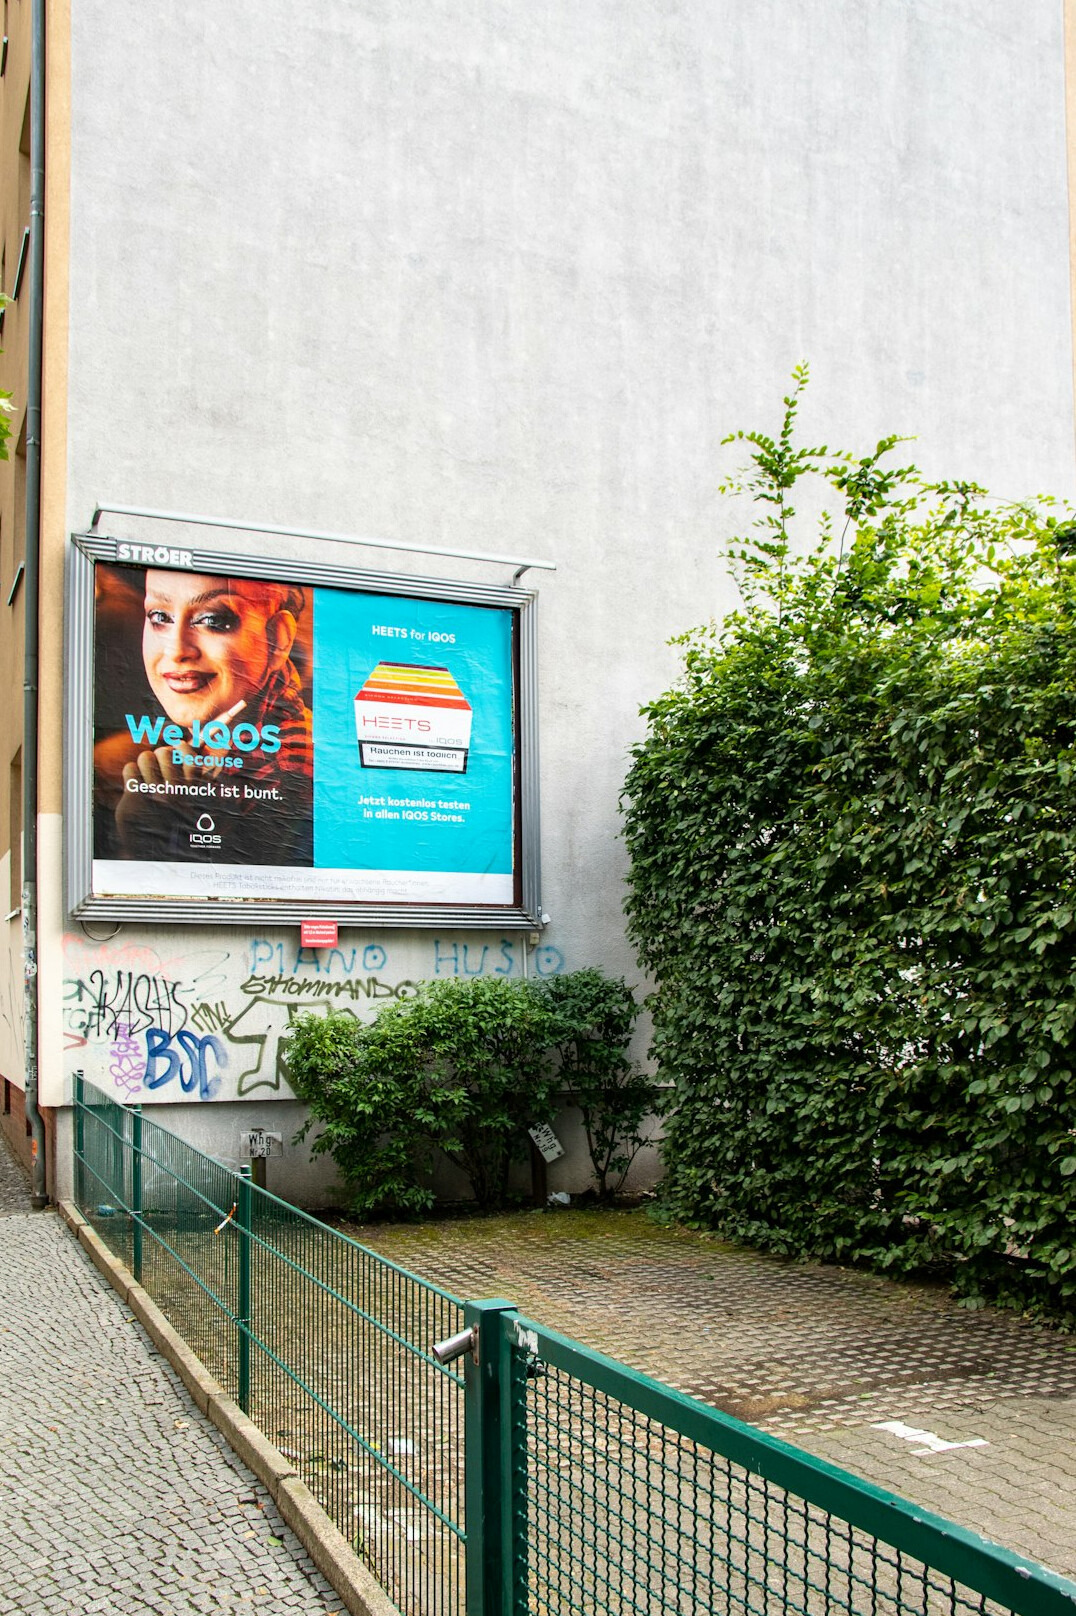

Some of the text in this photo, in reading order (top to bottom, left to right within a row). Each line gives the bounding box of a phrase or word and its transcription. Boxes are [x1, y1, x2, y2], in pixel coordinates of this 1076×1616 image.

[118, 543, 193, 567] STRÖER
[371, 625, 456, 644] HEETS for IQOS
[362, 715, 431, 732] HEETS
[125, 714, 282, 753] We IQOS
[436, 737, 463, 746] IQOS
[172, 750, 243, 768] Because
[370, 747, 411, 756] Rauchen
[413, 749, 424, 757] ist
[126, 778, 283, 800] Geschmack ist bunt.
[357, 795, 471, 810] Jetzt kostenlos testen
[375, 808, 400, 819] allen
[402, 810, 429, 821] IQOS
[430, 811, 466, 823] Stores.
[189, 833, 222, 844] IQOS
[251, 936, 387, 975] PIANO
[260, 1147, 271, 1156] 20
